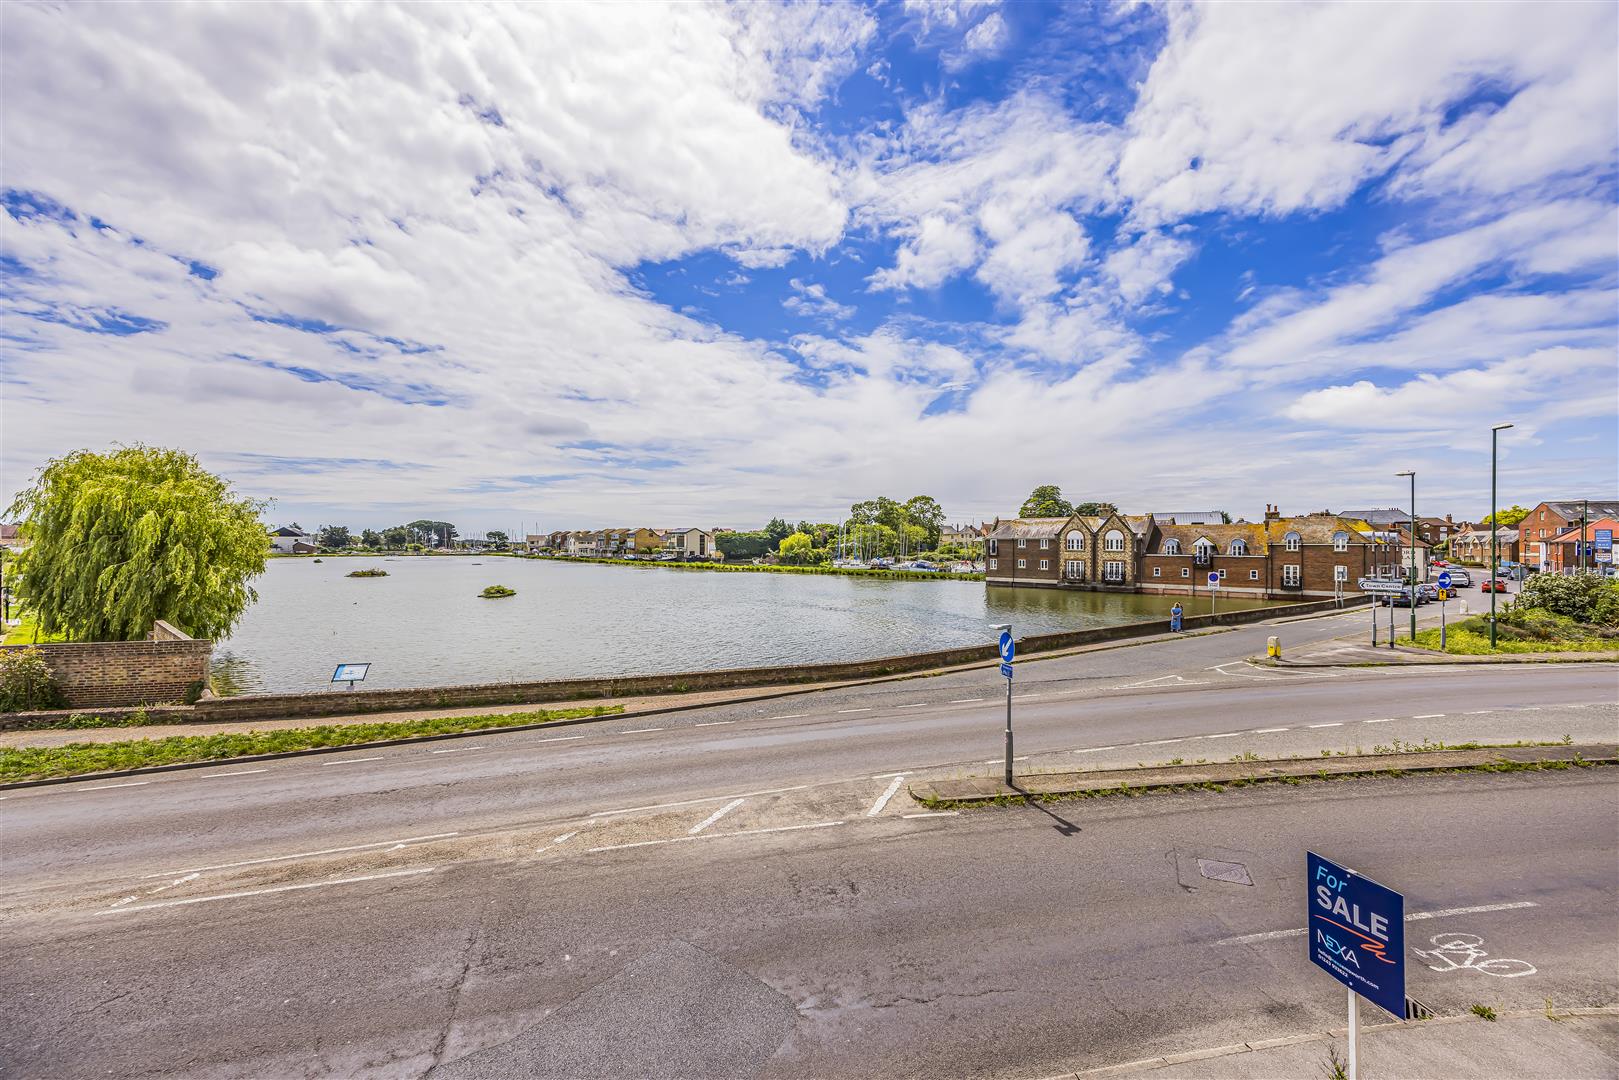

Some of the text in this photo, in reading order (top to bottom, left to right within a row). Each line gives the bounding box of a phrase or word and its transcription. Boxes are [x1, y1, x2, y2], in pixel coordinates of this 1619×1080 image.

[1316, 865, 1347, 892] For
[1317, 885, 1389, 941] SALE
[1317, 928, 1360, 969] NEXA
